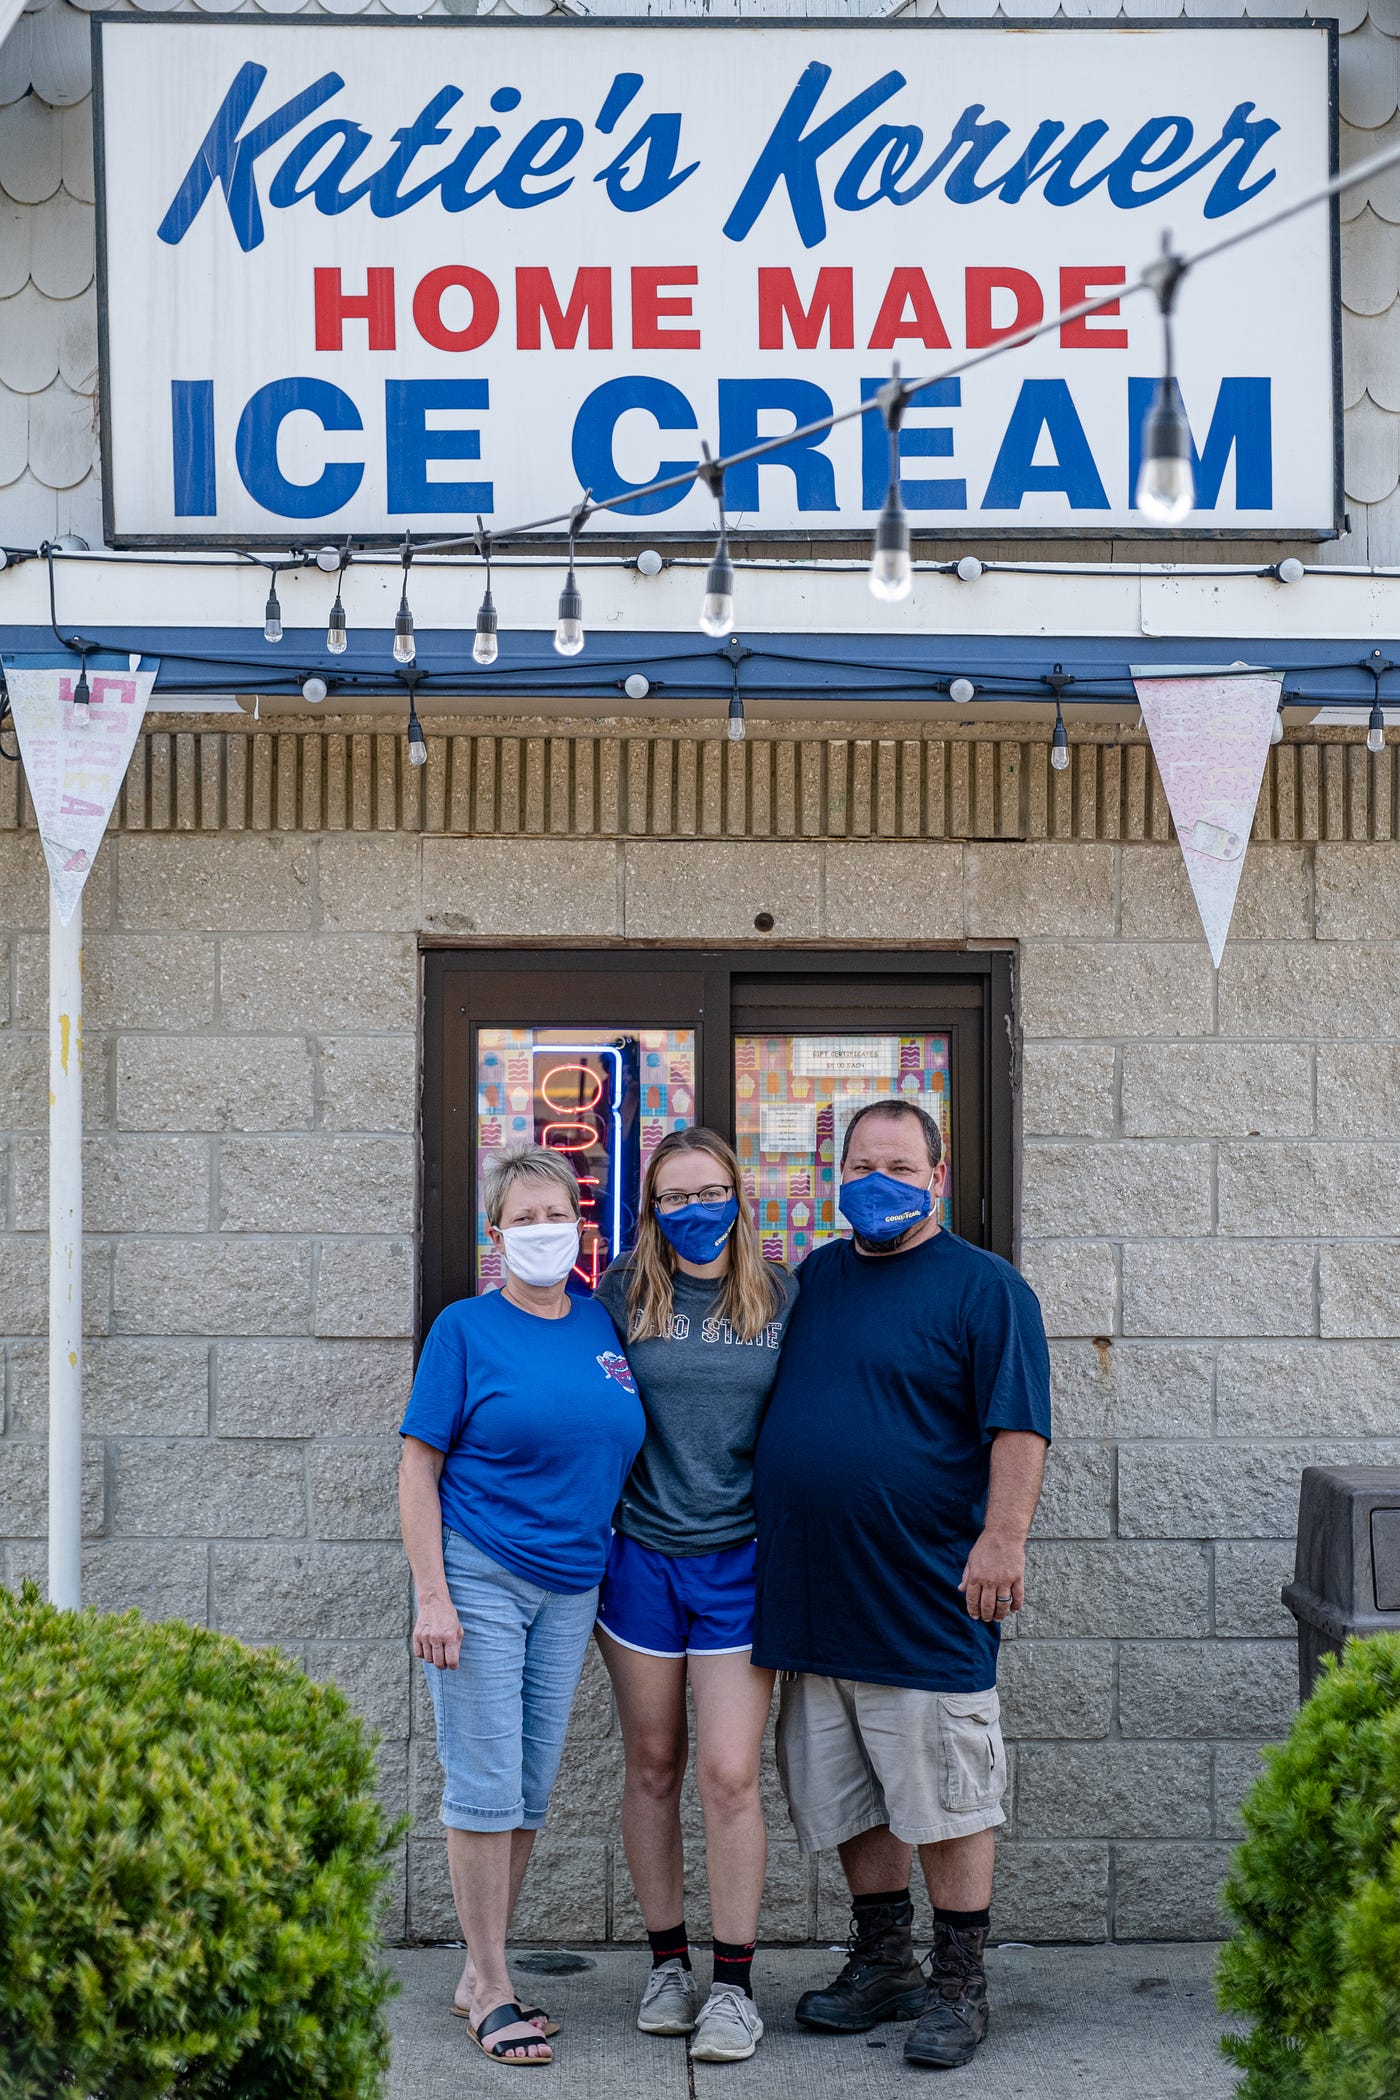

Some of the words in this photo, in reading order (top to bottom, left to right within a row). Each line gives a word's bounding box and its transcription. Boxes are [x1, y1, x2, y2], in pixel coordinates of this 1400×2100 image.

[158, 61, 700, 252] Katie's
[722, 61, 1281, 248] Korner
[314, 265, 701, 352] HOME
[758, 266, 1128, 350] MADE
[172, 377, 495, 519] ICE
[571, 376, 1273, 516] CREAM
[701, 1317, 783, 1349] STE
